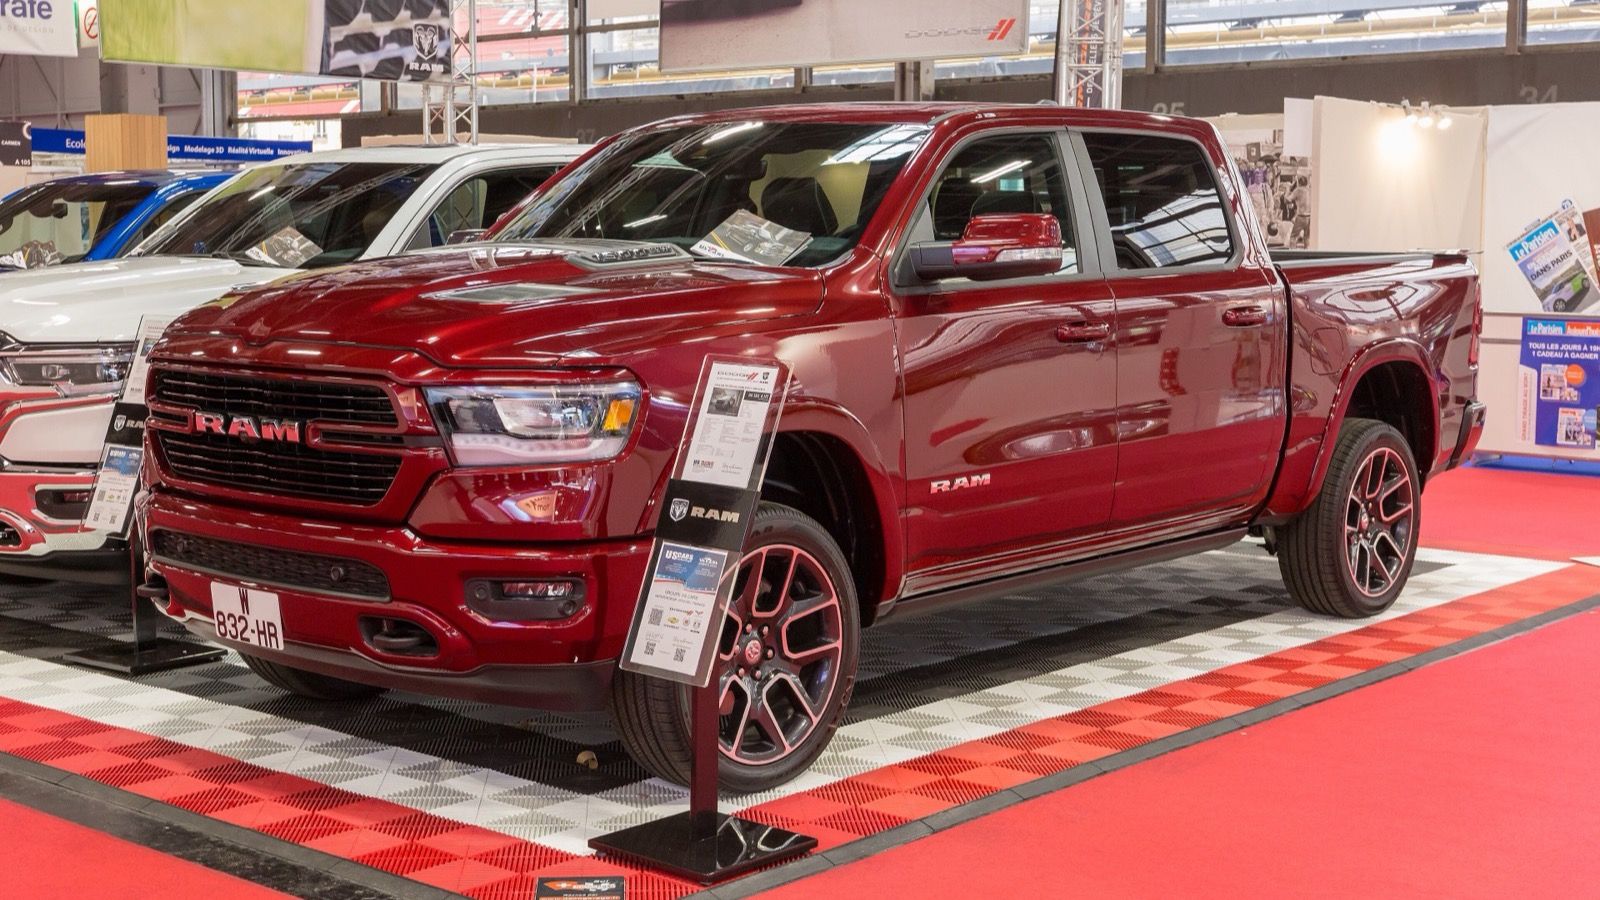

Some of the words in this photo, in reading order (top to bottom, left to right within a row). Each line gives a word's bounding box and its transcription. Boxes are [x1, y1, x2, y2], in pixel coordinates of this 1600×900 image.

[409, 61, 444, 73] RAM
[184, 144, 215, 155] Modelage
[215, 146, 225, 154] 3D
[249, 147, 274, 155] Virtuelle
[1530, 262, 1552, 281] DANS
[1551, 249, 1573, 269] PARIS
[1570, 352, 1599, 360] GAGNER
[126, 419, 145, 429] RA
[195, 411, 300, 443] RAM
[930, 473, 991, 494] RAM
[690, 505, 740, 523] RAM
[238, 587, 250, 616] W
[216, 610, 279, 649] 832-HR
